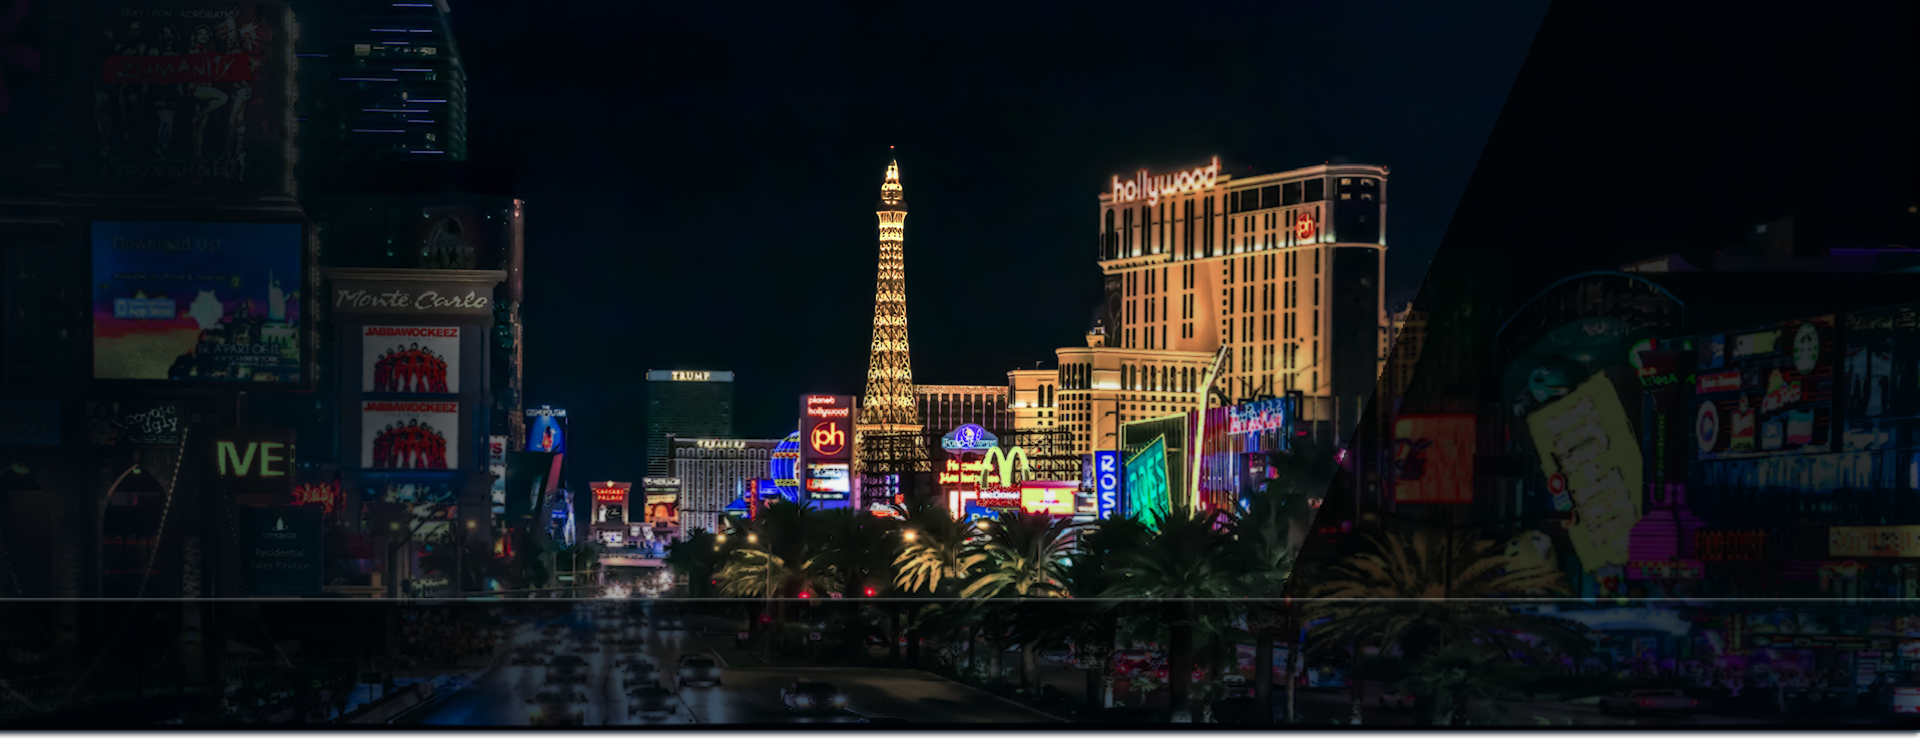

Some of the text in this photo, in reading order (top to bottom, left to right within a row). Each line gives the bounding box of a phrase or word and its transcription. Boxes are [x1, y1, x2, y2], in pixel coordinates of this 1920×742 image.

[120, 8, 145, 17] SEXY
[152, 10, 172, 18] FUN
[115, 53, 236, 82] ZUMANITY
[118, 164, 164, 177] CIRQUE
[168, 165, 186, 177] DU
[1112, 156, 1218, 206] hollywood
[112, 236, 221, 251] Download Us!
[335, 289, 488, 310] Monte Carlo
[365, 327, 458, 338] JABBAWOCKEEZ
[671, 371, 710, 381] TRUMP
[807, 395, 836, 405] planet
[364, 402, 457, 413] JABBAWOCKEEZ
[807, 406, 849, 418] hollywood
[255, 548, 306, 557] Residential
[249, 561, 311, 570] Sales Pavilion
